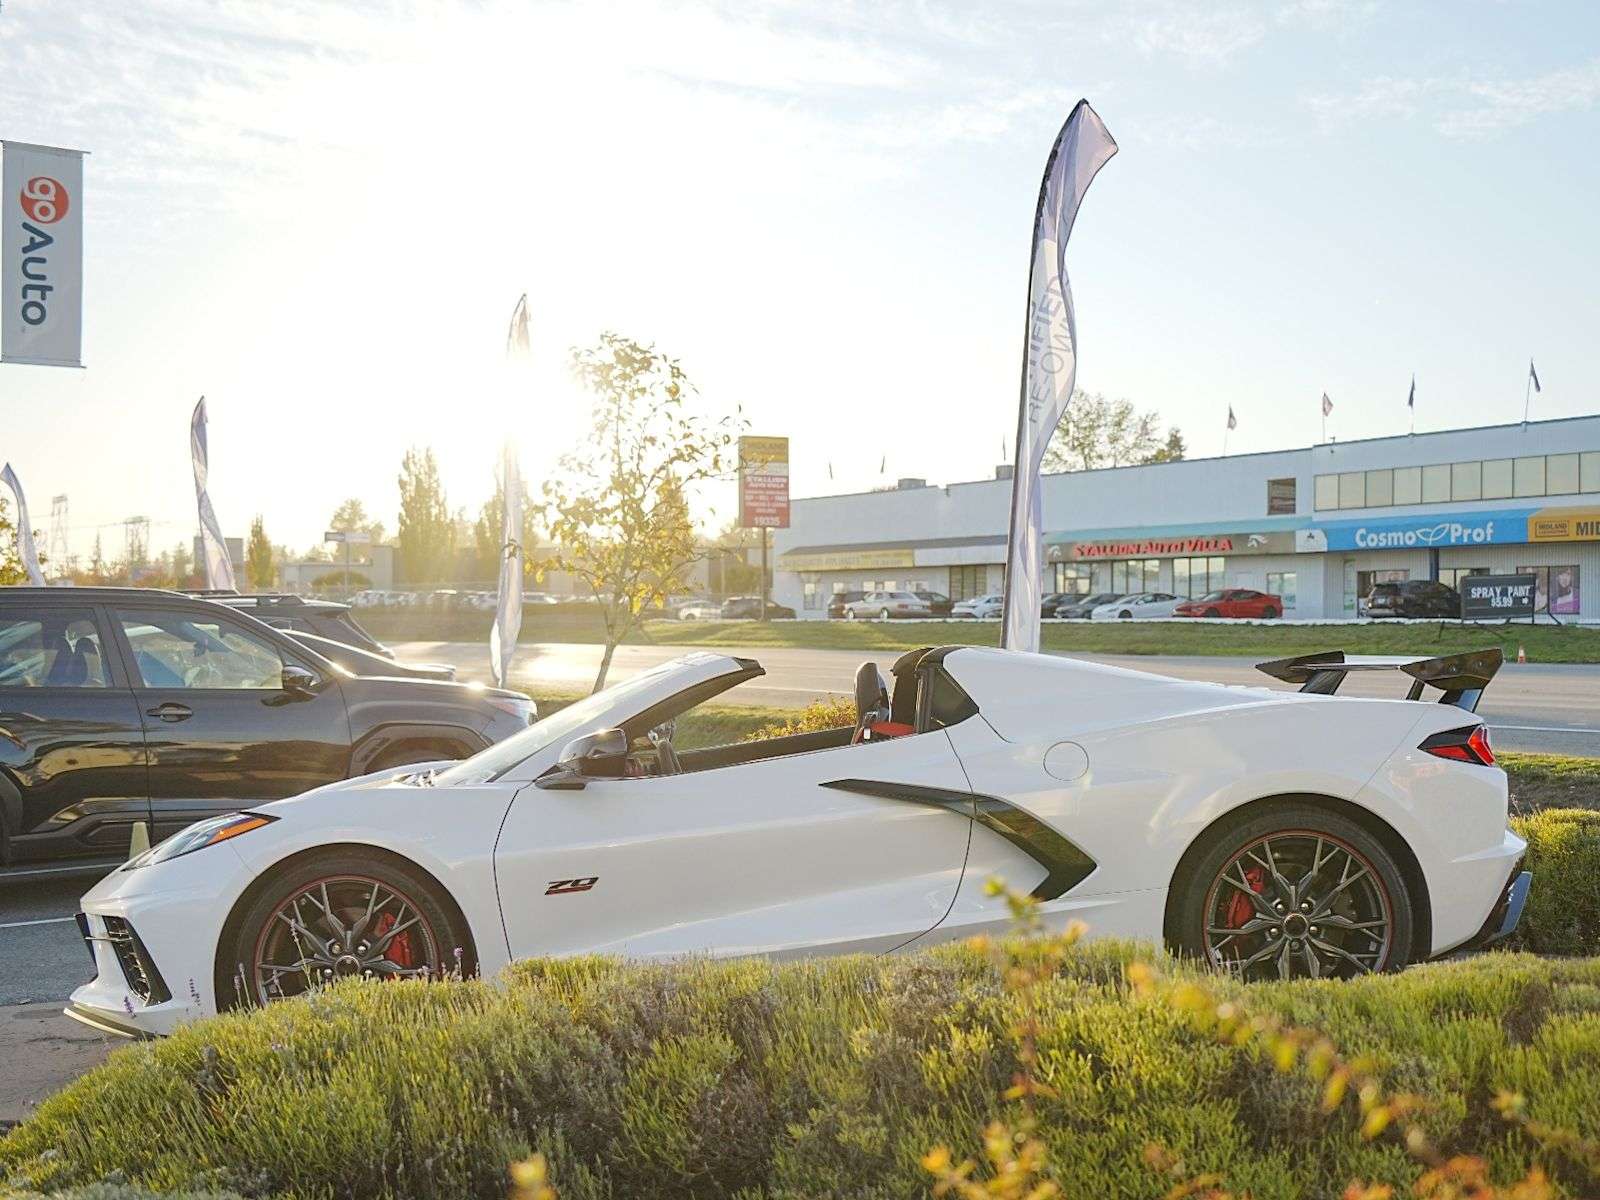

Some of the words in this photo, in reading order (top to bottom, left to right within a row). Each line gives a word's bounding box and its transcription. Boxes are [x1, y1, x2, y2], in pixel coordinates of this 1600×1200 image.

[1355, 528, 1417, 547] Cosmo
[1450, 521, 1494, 543] Prof
[1073, 543, 1140, 558] STALLION
[1143, 541, 1184, 555] AUTO
[1185, 538, 1233, 553] VILLA
[1471, 585, 1502, 598] SPRAY
[1507, 584, 1533, 597] PAINT
